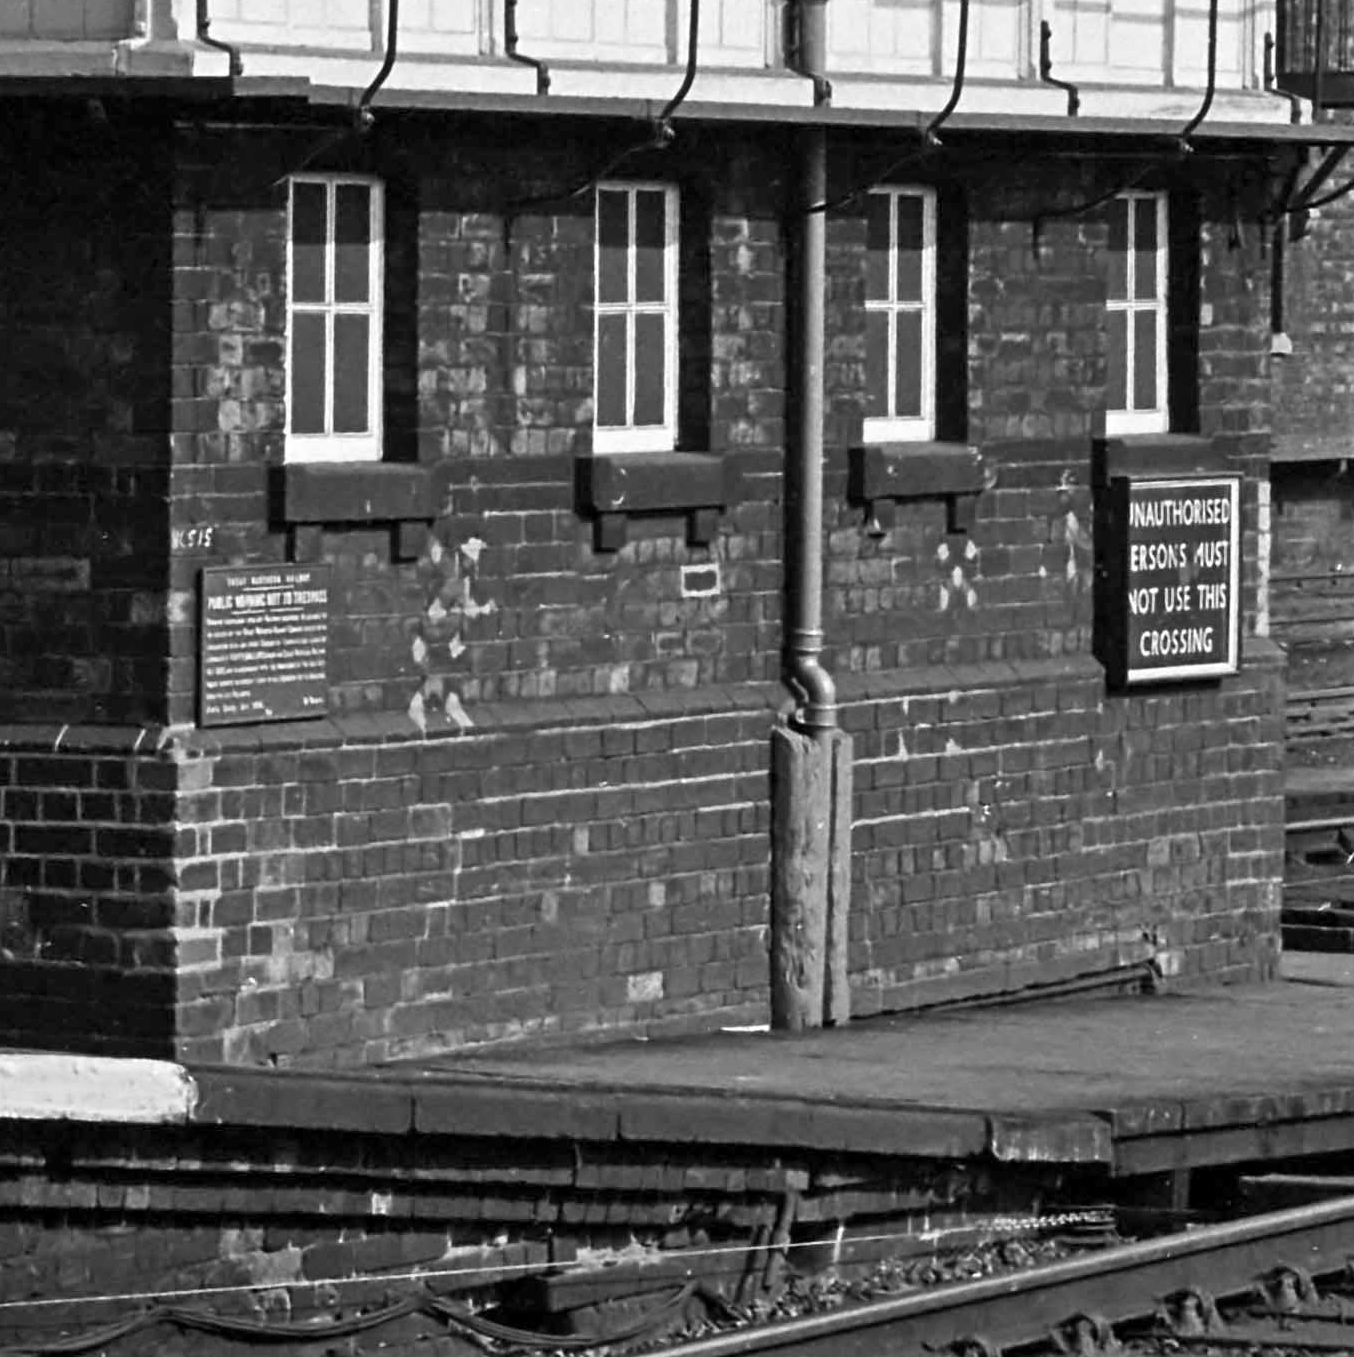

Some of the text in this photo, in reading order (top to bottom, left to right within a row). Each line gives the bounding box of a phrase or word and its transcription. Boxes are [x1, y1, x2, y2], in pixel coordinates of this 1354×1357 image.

[1130, 543, 1187, 572] ERSONS
[1128, 582, 1227, 615] NOT USE THIS
[1139, 626, 1215, 657] CROSSING
